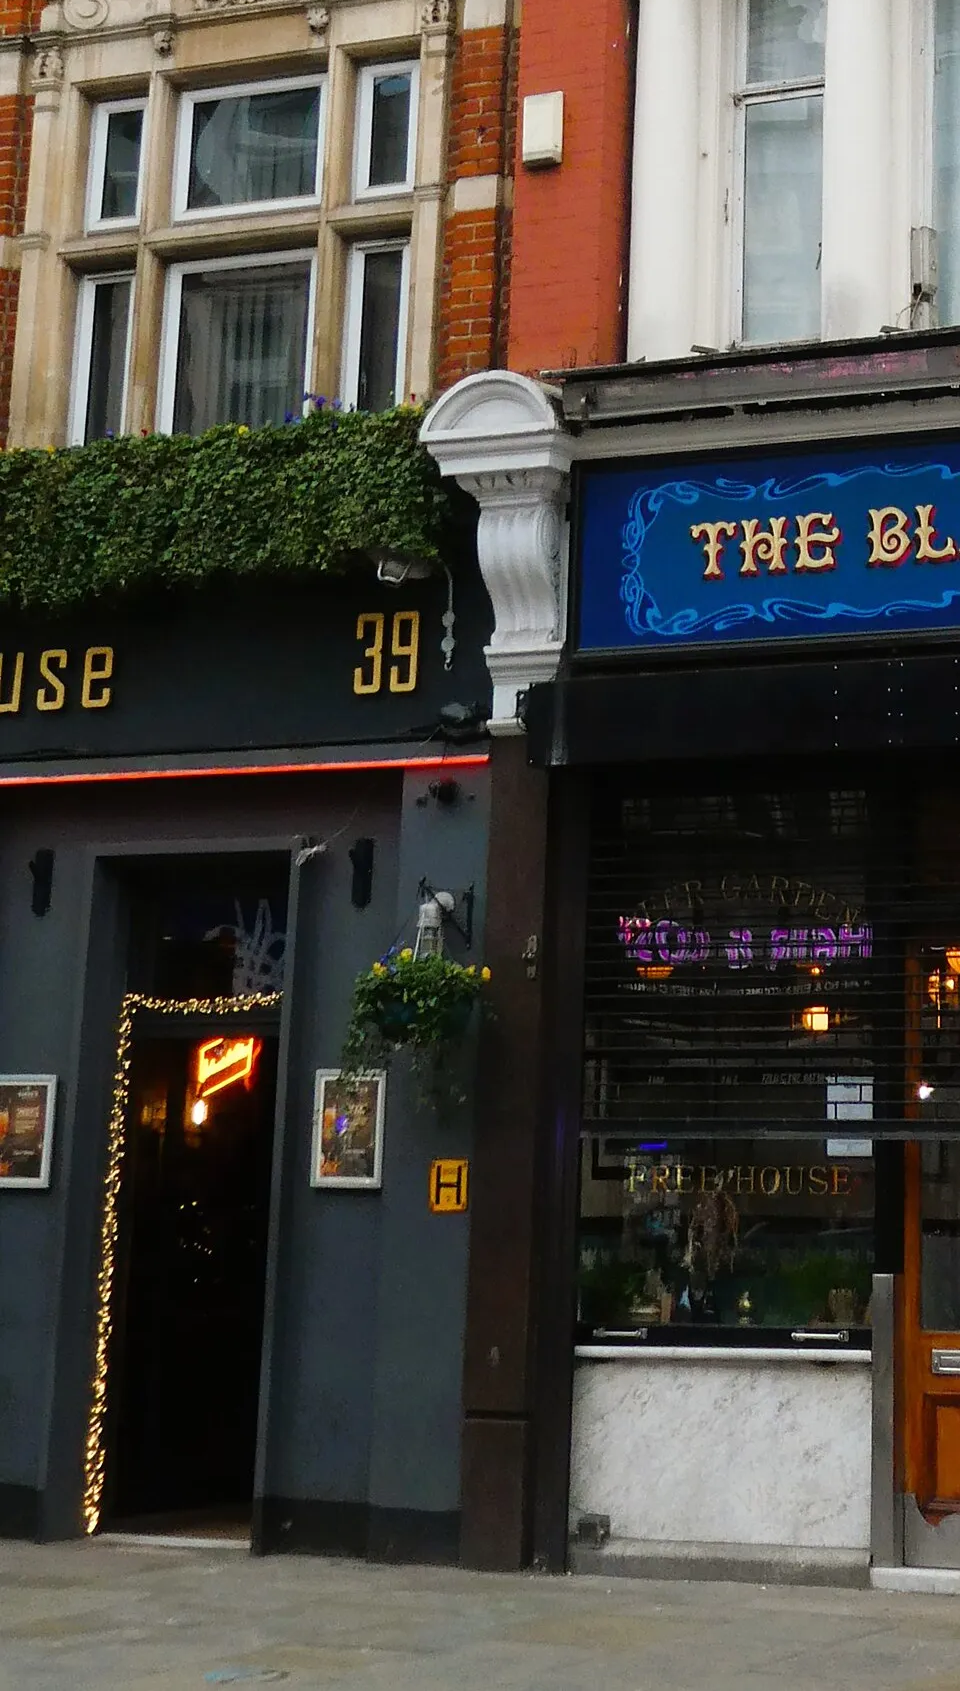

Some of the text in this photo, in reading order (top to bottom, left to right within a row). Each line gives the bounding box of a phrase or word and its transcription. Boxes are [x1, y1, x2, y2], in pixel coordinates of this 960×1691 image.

[690, 511, 843, 580] THE
[353, 610, 421, 696] 39
[435, 1165, 462, 1205] H
[626, 1162, 853, 1196] FREE HOUSE
